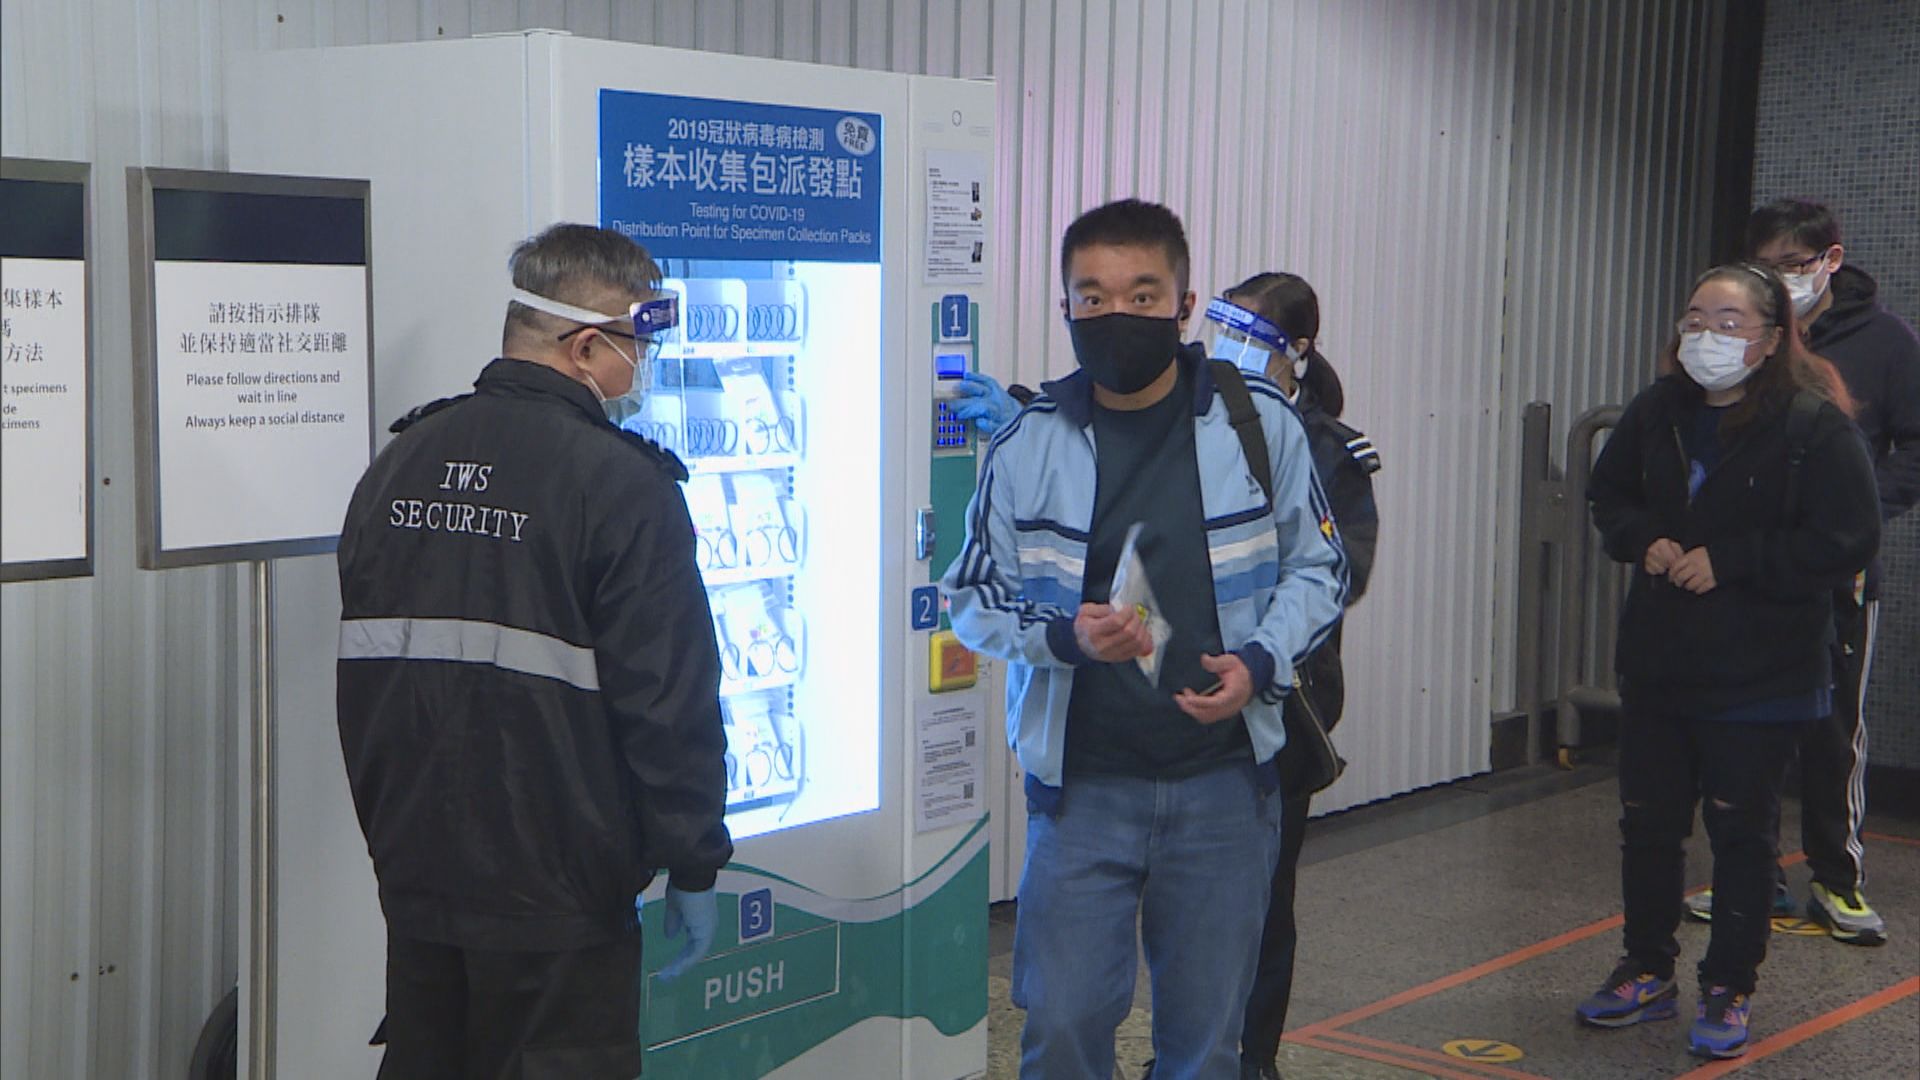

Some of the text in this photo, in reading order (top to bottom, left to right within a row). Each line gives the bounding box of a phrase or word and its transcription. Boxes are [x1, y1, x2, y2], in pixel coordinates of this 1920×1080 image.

[668, 118, 825, 151] 2019冠狀病毒病檢測
[843, 137, 866, 151] FREE
[844, 121, 869, 144] 免費
[622, 142, 863, 201] 樣本收集包派發點
[689, 202, 805, 223] Testing for COVID-19
[612, 220, 872, 245] Distribution Point for Specimen Collection Packs
[209, 302, 320, 323] 請按指示排隊
[949, 303, 961, 333] 1
[5, 342, 43, 363] 方法
[179, 332, 347, 354] 並保持適當社交距離
[11, 383, 68, 396] specimens
[186, 370, 340, 386] Please follow directions and
[237, 390, 297, 403] wait in line
[185, 410, 345, 430] Always keep a social distance
[439, 462, 493, 491] IWS
[389, 499, 529, 541] SECURITY
[919, 595, 932, 624] 2
[748, 901, 763, 929] 3
[704, 960, 785, 1009] PUSH
